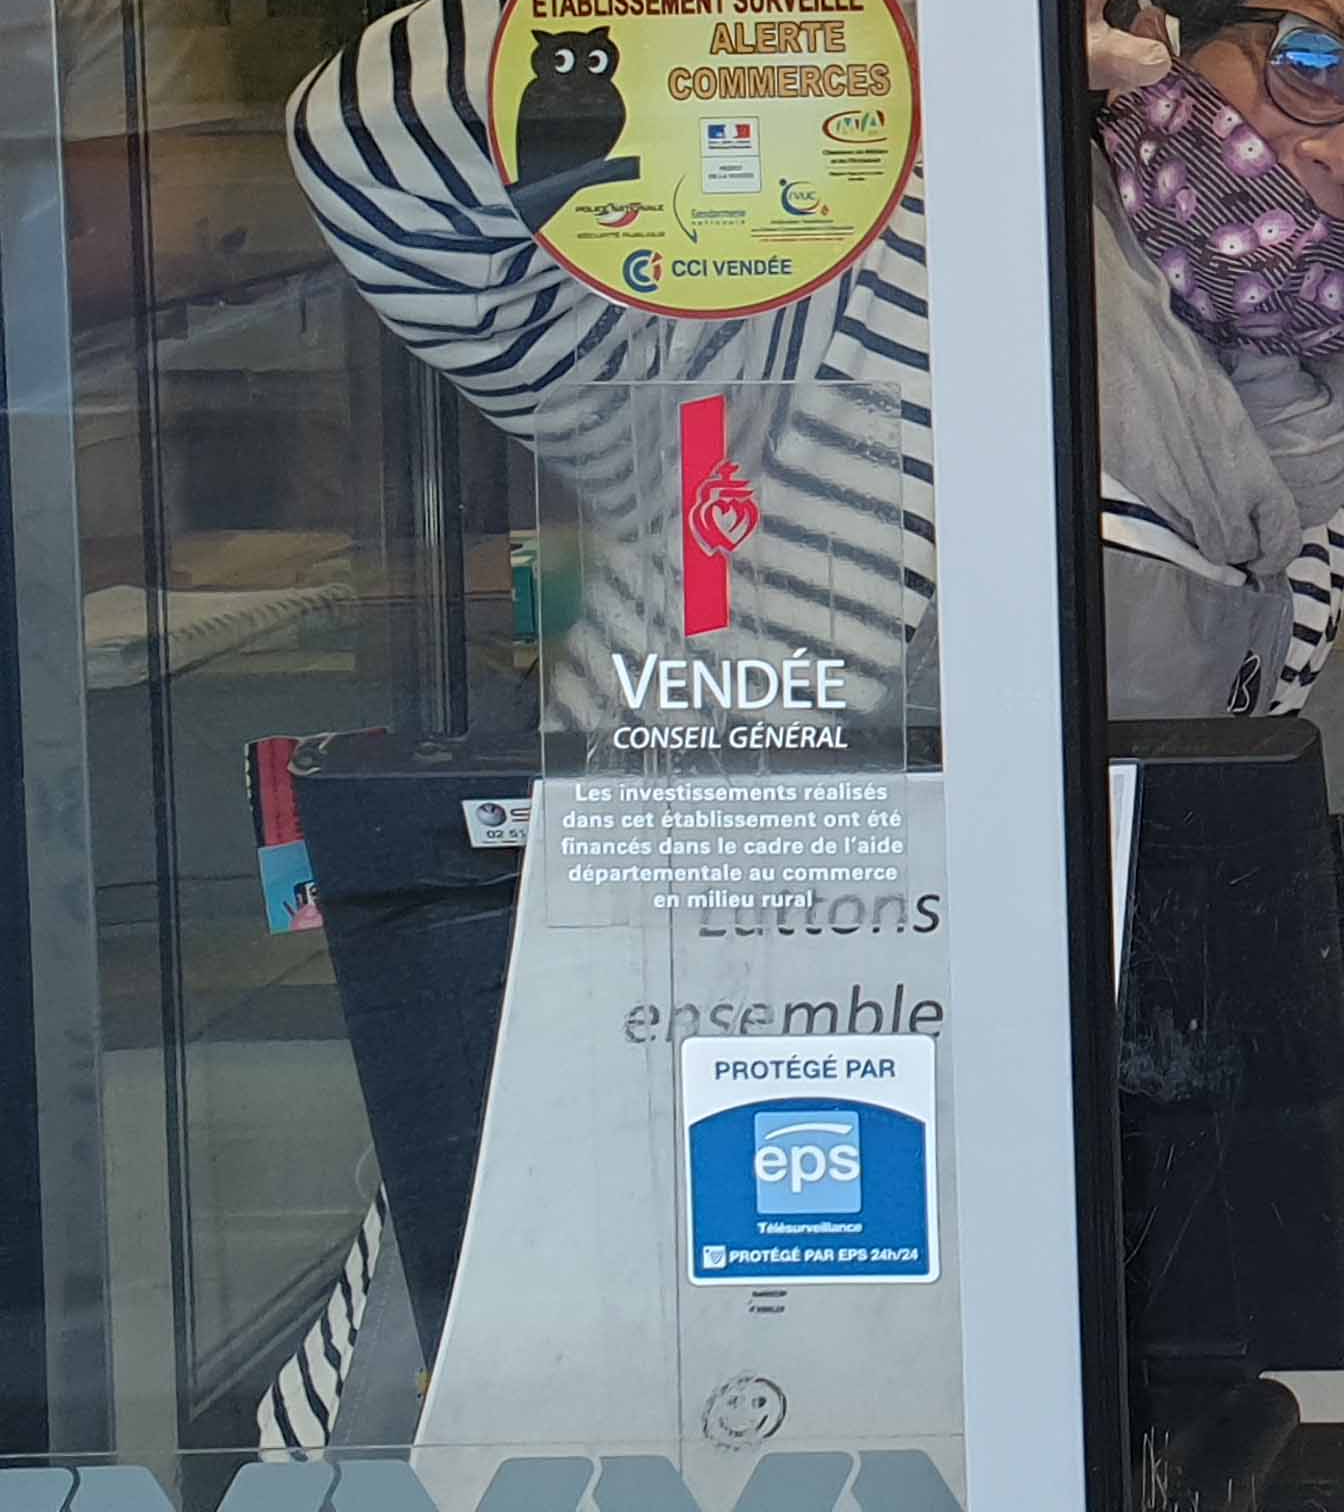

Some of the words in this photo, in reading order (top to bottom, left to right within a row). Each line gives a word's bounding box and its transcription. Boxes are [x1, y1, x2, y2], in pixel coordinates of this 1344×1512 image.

[710, 20, 846, 55] ALERTE
[668, 64, 891, 100] COMMERCES
[671, 258, 707, 277] CCI
[712, 255, 793, 276] VENDÉE
[611, 647, 848, 710] VENDÉE
[613, 726, 722, 750] CONSEIL
[728, 721, 849, 750] GÉNÉRAL
[575, 783, 612, 802] Les
[620, 783, 797, 803] investissements
[803, 781, 888, 802] réalisés
[562, 811, 615, 830] dans
[621, 811, 655, 830] cet
[661, 809, 817, 829] établissement
[824, 811, 861, 828] ont
[867, 809, 902, 828] été
[561, 836, 652, 856] financés
[658, 836, 711, 856] dans
[718, 836, 737, 855] le
[743, 836, 804, 855] cadre
[811, 836, 837, 855] de
[568, 861, 742, 886] départementale
[749, 865, 775, 882] au
[782, 864, 898, 882] commerce
[653, 892, 679, 909] en
[687, 889, 754, 908] milieu
[761, 889, 813, 908] rural
[715, 1054, 838, 1081] PROTÉGÉ
[846, 1059, 896, 1079] PAR
[755, 1144, 861, 1194] eps
[757, 1221, 863, 1235] Télésurveillance
[728, 1246, 801, 1264] PROTÉGÉ
[804, 1248, 834, 1262] PAR
[839, 1248, 867, 1262] EPS
[870, 1247, 919, 1262] 24h/24
